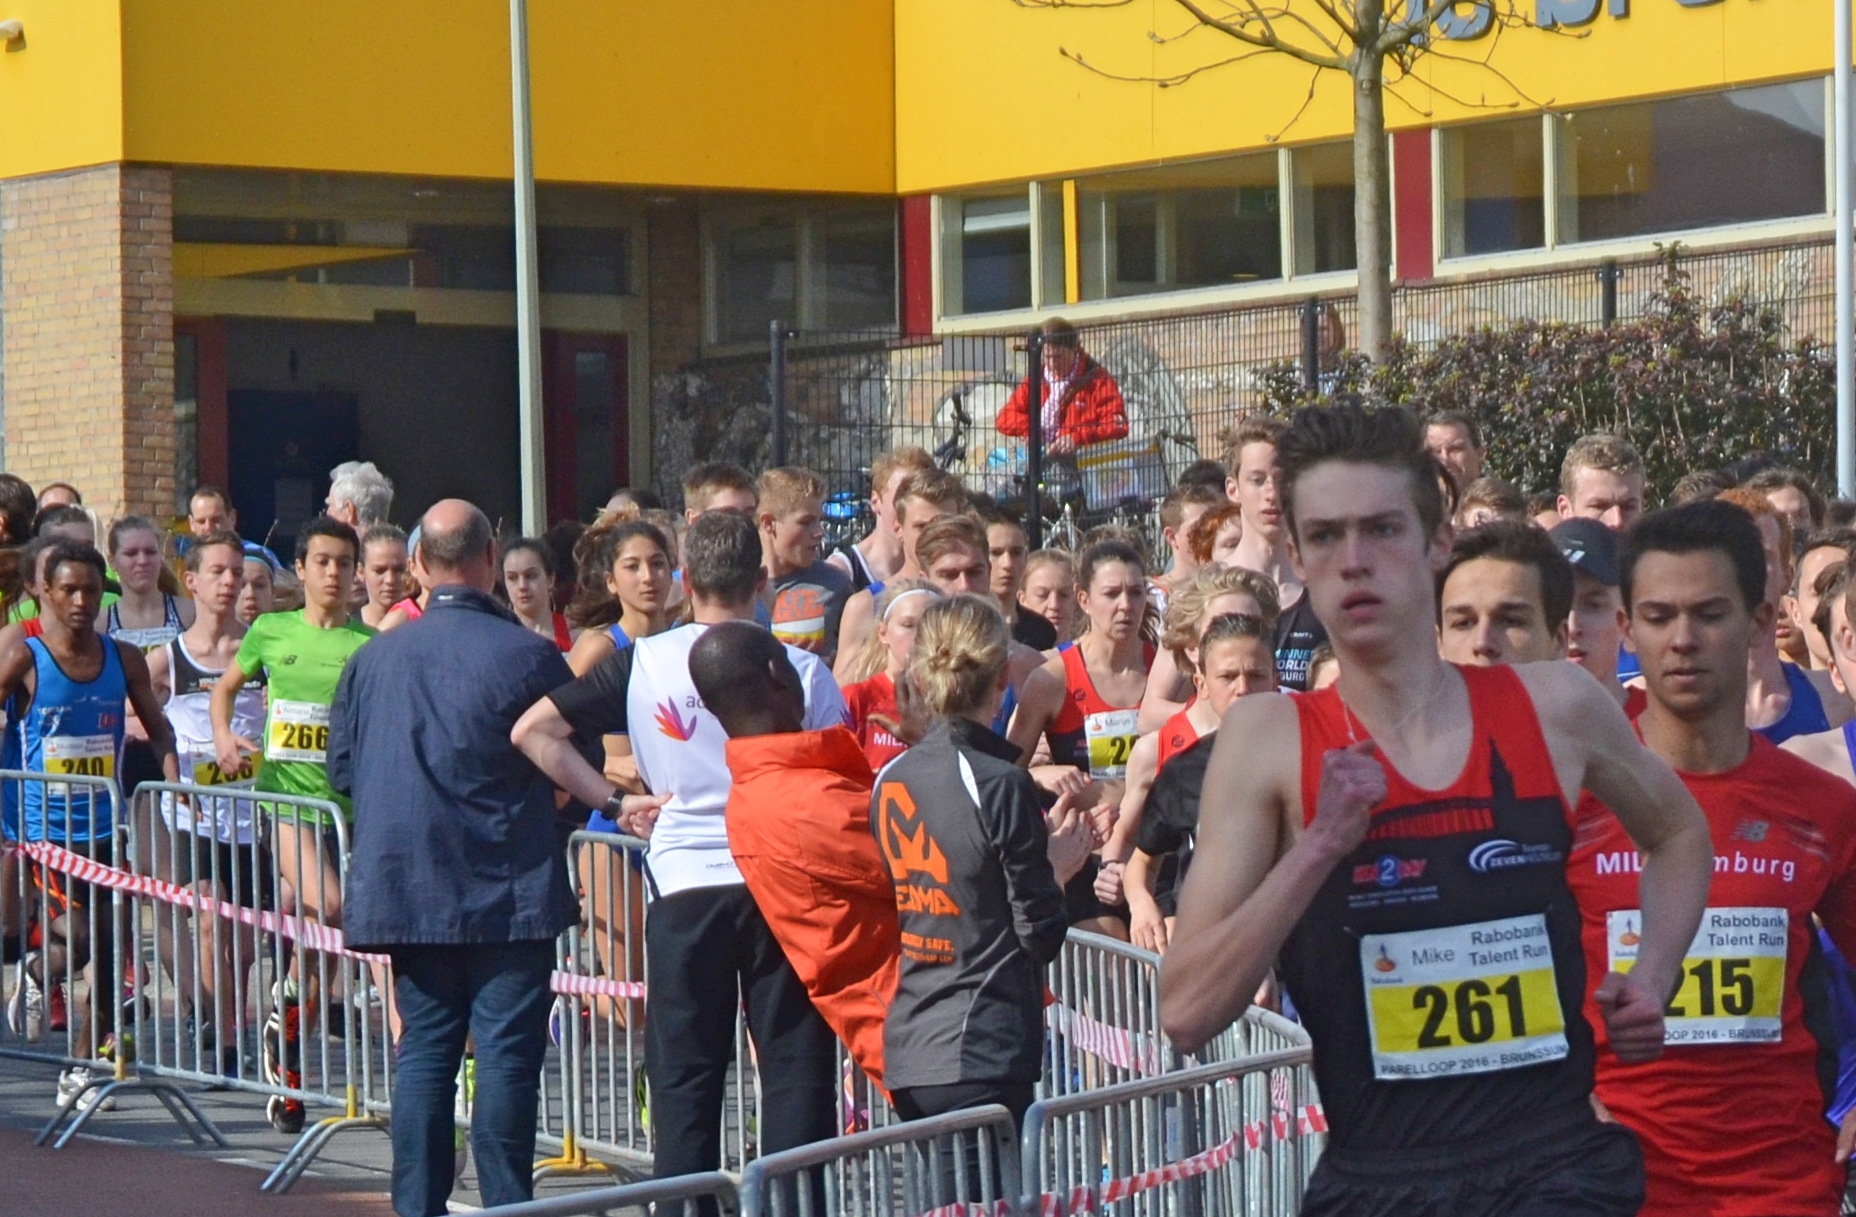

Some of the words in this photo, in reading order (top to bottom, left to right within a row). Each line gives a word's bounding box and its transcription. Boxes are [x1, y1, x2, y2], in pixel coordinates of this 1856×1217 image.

[281, 721, 329, 751] 266
[61, 756, 104, 776] 240
[1711, 914, 1784, 929] Rabobank
[1471, 925, 1544, 946] Rabobank
[1707, 933, 1754, 947] Talent
[1758, 933, 1785, 946] Run
[1411, 947, 1456, 966] Mike
[1468, 950, 1519, 967] Talent
[1523, 944, 1548, 958] Run
[1412, 973, 1527, 1049] 261
[1692, 1029, 1719, 1040] 2016
[1380, 1059, 1457, 1076] PARELLOOP
[1459, 1058, 1490, 1070] 2016
[1500, 1042, 1569, 1064] BRUNSSUM
